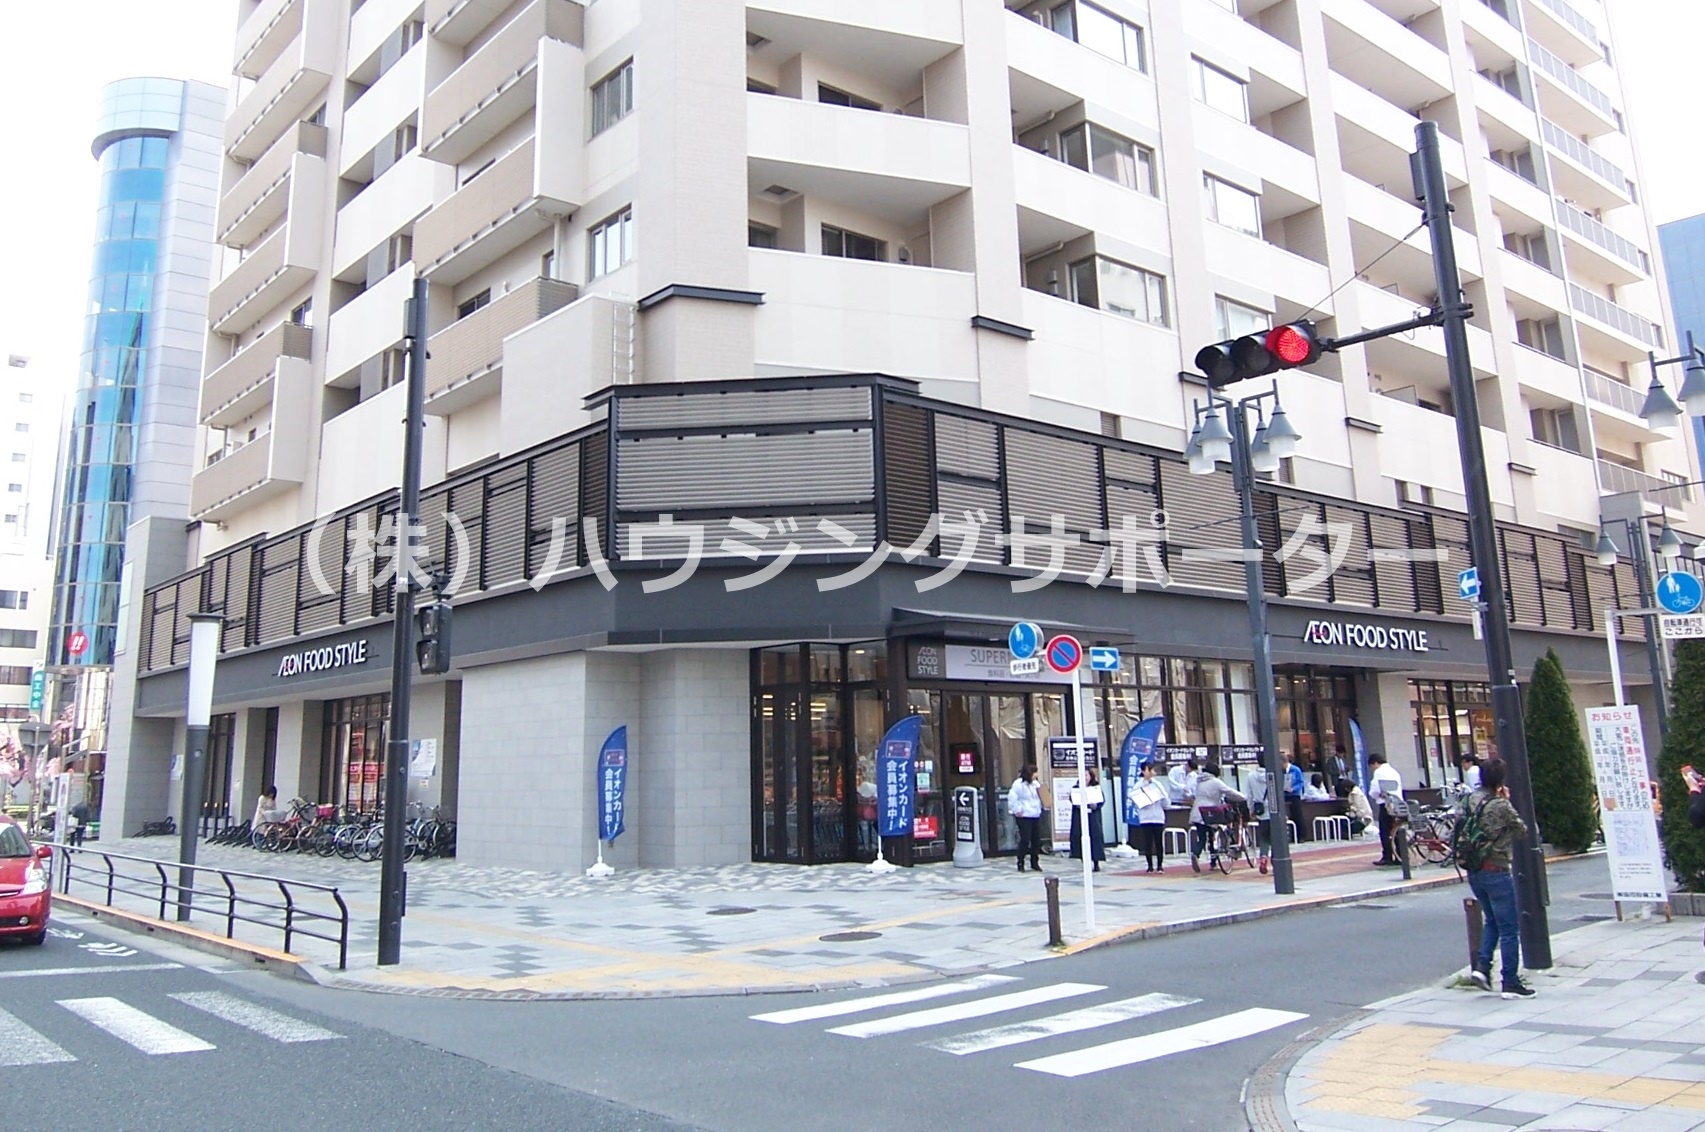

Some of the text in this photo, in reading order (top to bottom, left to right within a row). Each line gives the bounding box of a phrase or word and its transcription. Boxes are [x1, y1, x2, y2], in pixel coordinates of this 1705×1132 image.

[1345, 624, 1388, 648] FOOD
[1389, 628, 1429, 652] STYLE
[303, 647, 333, 672] FOOD
[334, 640, 367, 667] STYLE
[917, 656, 938, 666] FOOD
[918, 665, 939, 675] STYLE
[1592, 711, 1632, 721] お知らせ
[898, 760, 908, 829] イオンカード
